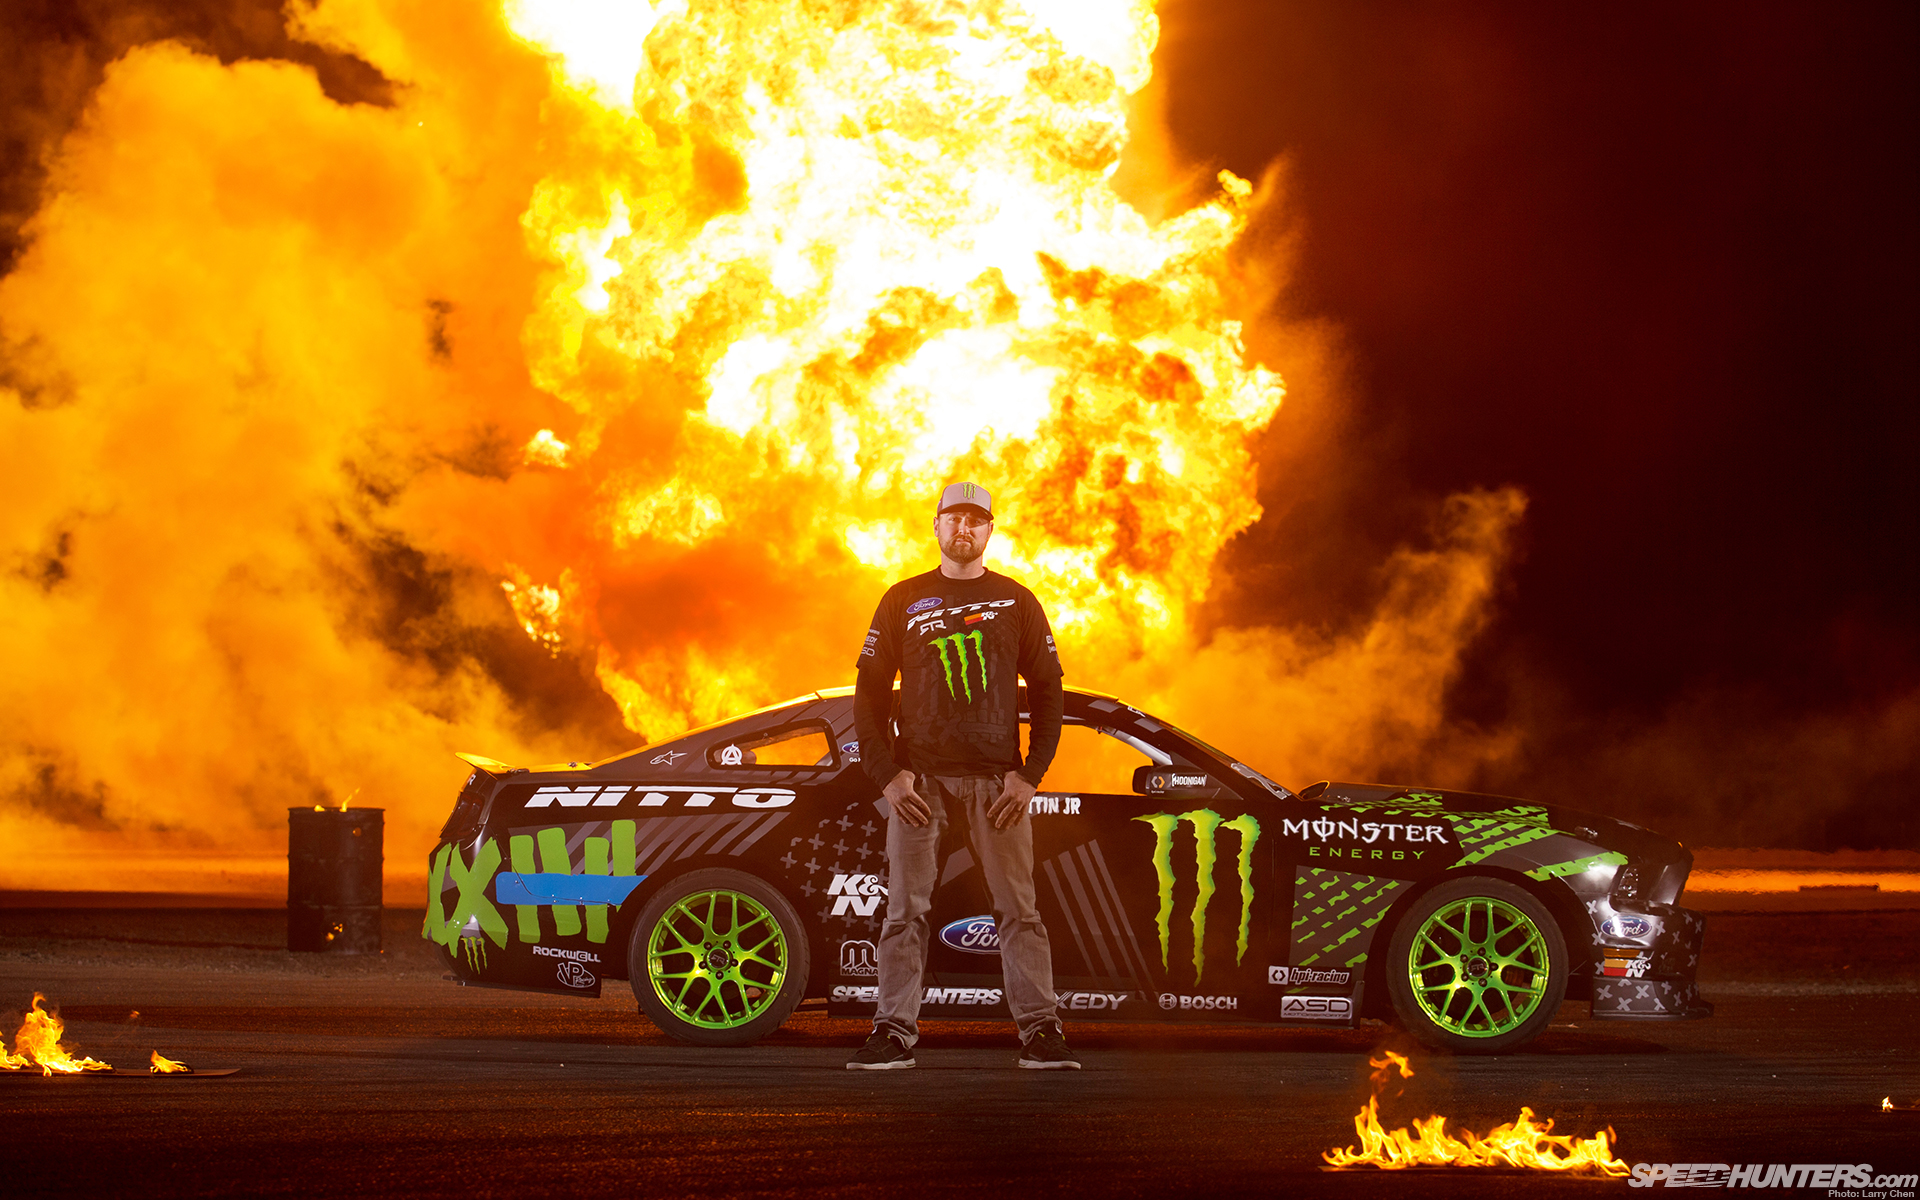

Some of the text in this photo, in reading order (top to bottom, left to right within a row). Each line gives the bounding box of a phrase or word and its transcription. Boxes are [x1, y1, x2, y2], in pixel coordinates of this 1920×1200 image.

[907, 599, 1016, 631] NITTO
[524, 785, 797, 809] NITTO
[1062, 797, 1081, 814] JR
[1309, 846, 1425, 861] ENERGY
[533, 945, 602, 963] ROCKWELL
[1179, 995, 1238, 1010] BOSCH
[1283, 998, 1350, 1012] ASD
